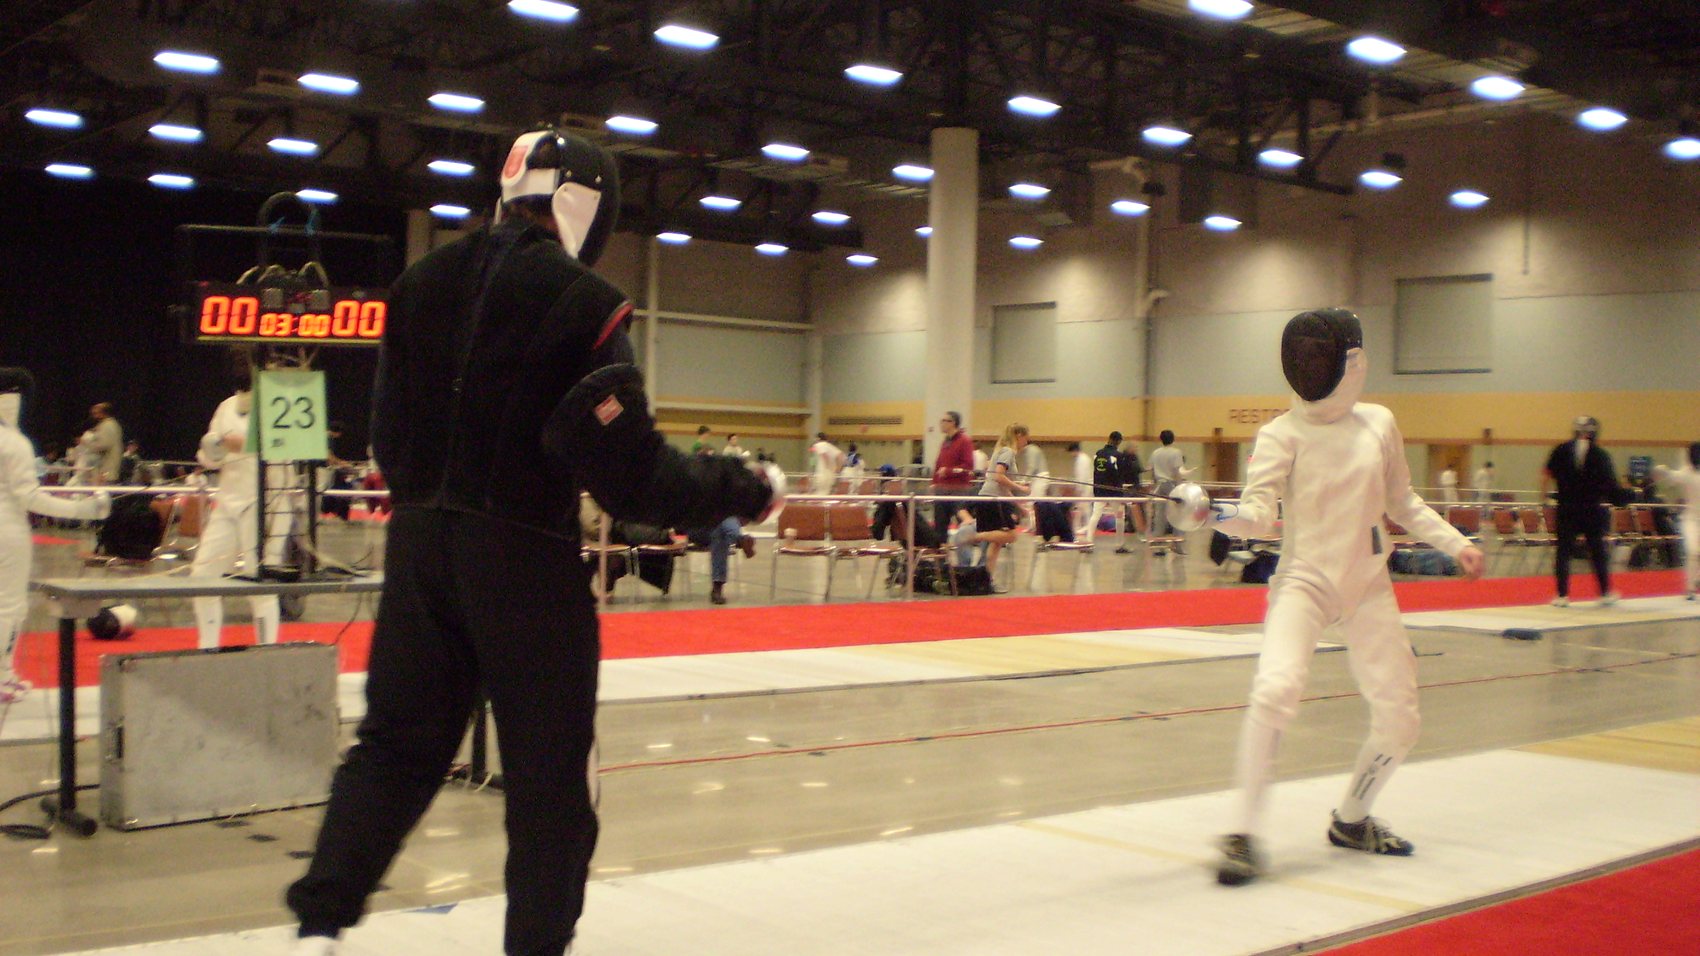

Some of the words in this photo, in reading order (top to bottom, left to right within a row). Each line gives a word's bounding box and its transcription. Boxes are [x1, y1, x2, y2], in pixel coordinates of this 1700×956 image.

[200, 295, 259, 335] 00
[259, 312, 331, 338] 03:00
[331, 299, 386, 338] 00
[271, 396, 316, 429] 23
